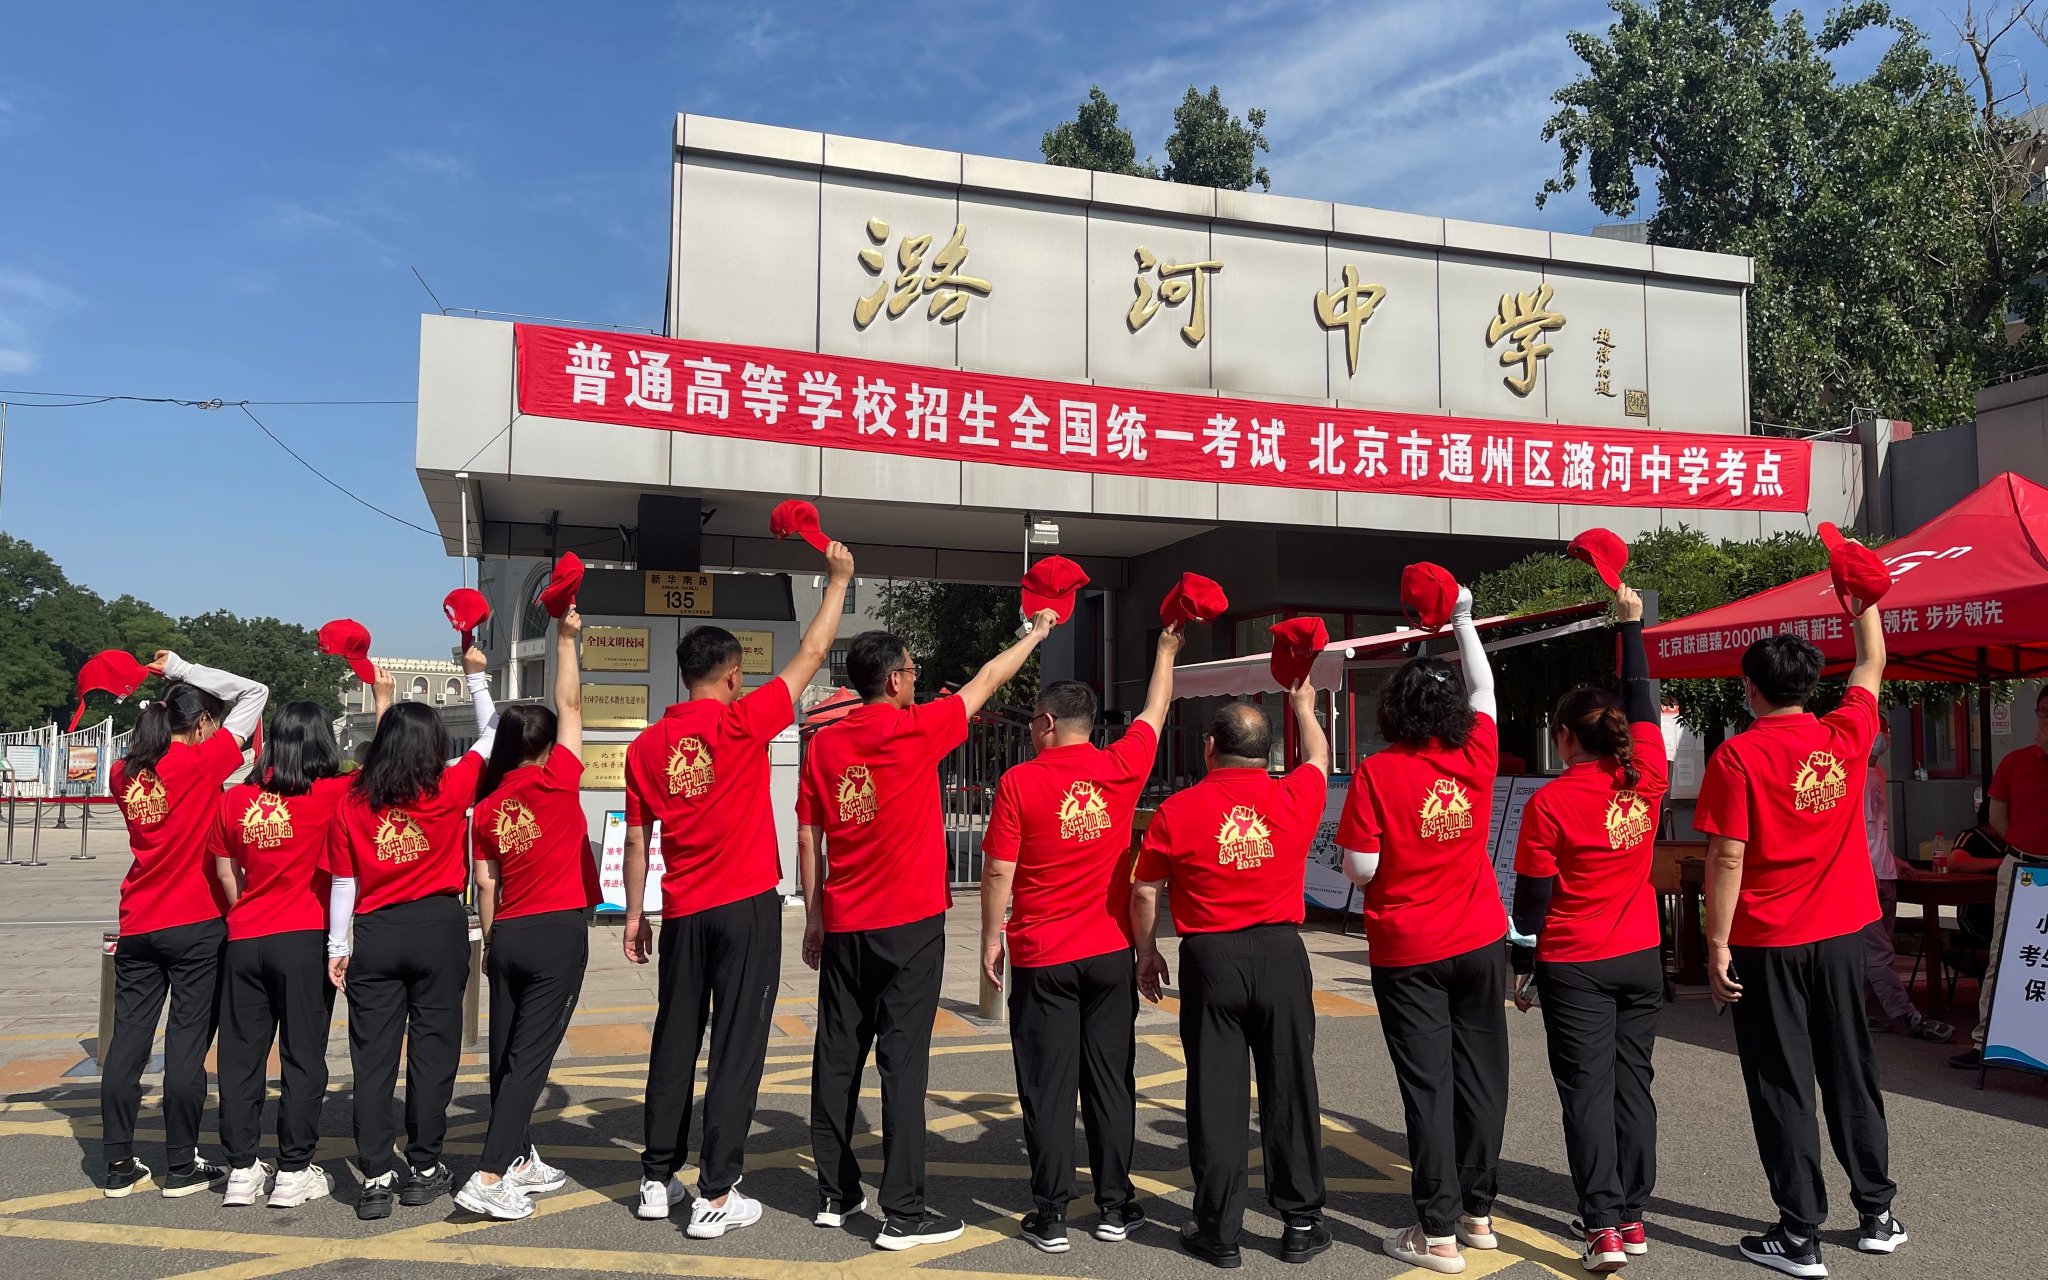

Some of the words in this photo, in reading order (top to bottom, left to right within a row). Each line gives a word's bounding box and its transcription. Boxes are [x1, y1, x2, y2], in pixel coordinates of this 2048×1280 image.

[854, 216, 1566, 396] 潞河中学
[566, 341, 1286, 472] 普通高等学校招生全国统一考试
[1308, 421, 1784, 498] 北京市通州区潞河中学考点
[651, 574, 708, 586] 新华南路
[664, 591, 694, 609] 135
[1926, 600, 2004, 630] 步步领先
[587, 635, 645, 649] 全国文明校园
[685, 785, 707, 798] 2023
[1813, 800, 1837, 813] 2023
[141, 815, 161, 825] 2023
[856, 813, 874, 825] 2023
[1078, 830, 1101, 842] 2023
[1438, 830, 1461, 841] 2023
[257, 839, 281, 849] 2023
[515, 841, 533, 854] 2023
[1625, 836, 1643, 850] 2023
[394, 853, 419, 864] 2023
[1237, 858, 1261, 870] 2023
[2024, 978, 2046, 1002] 保
